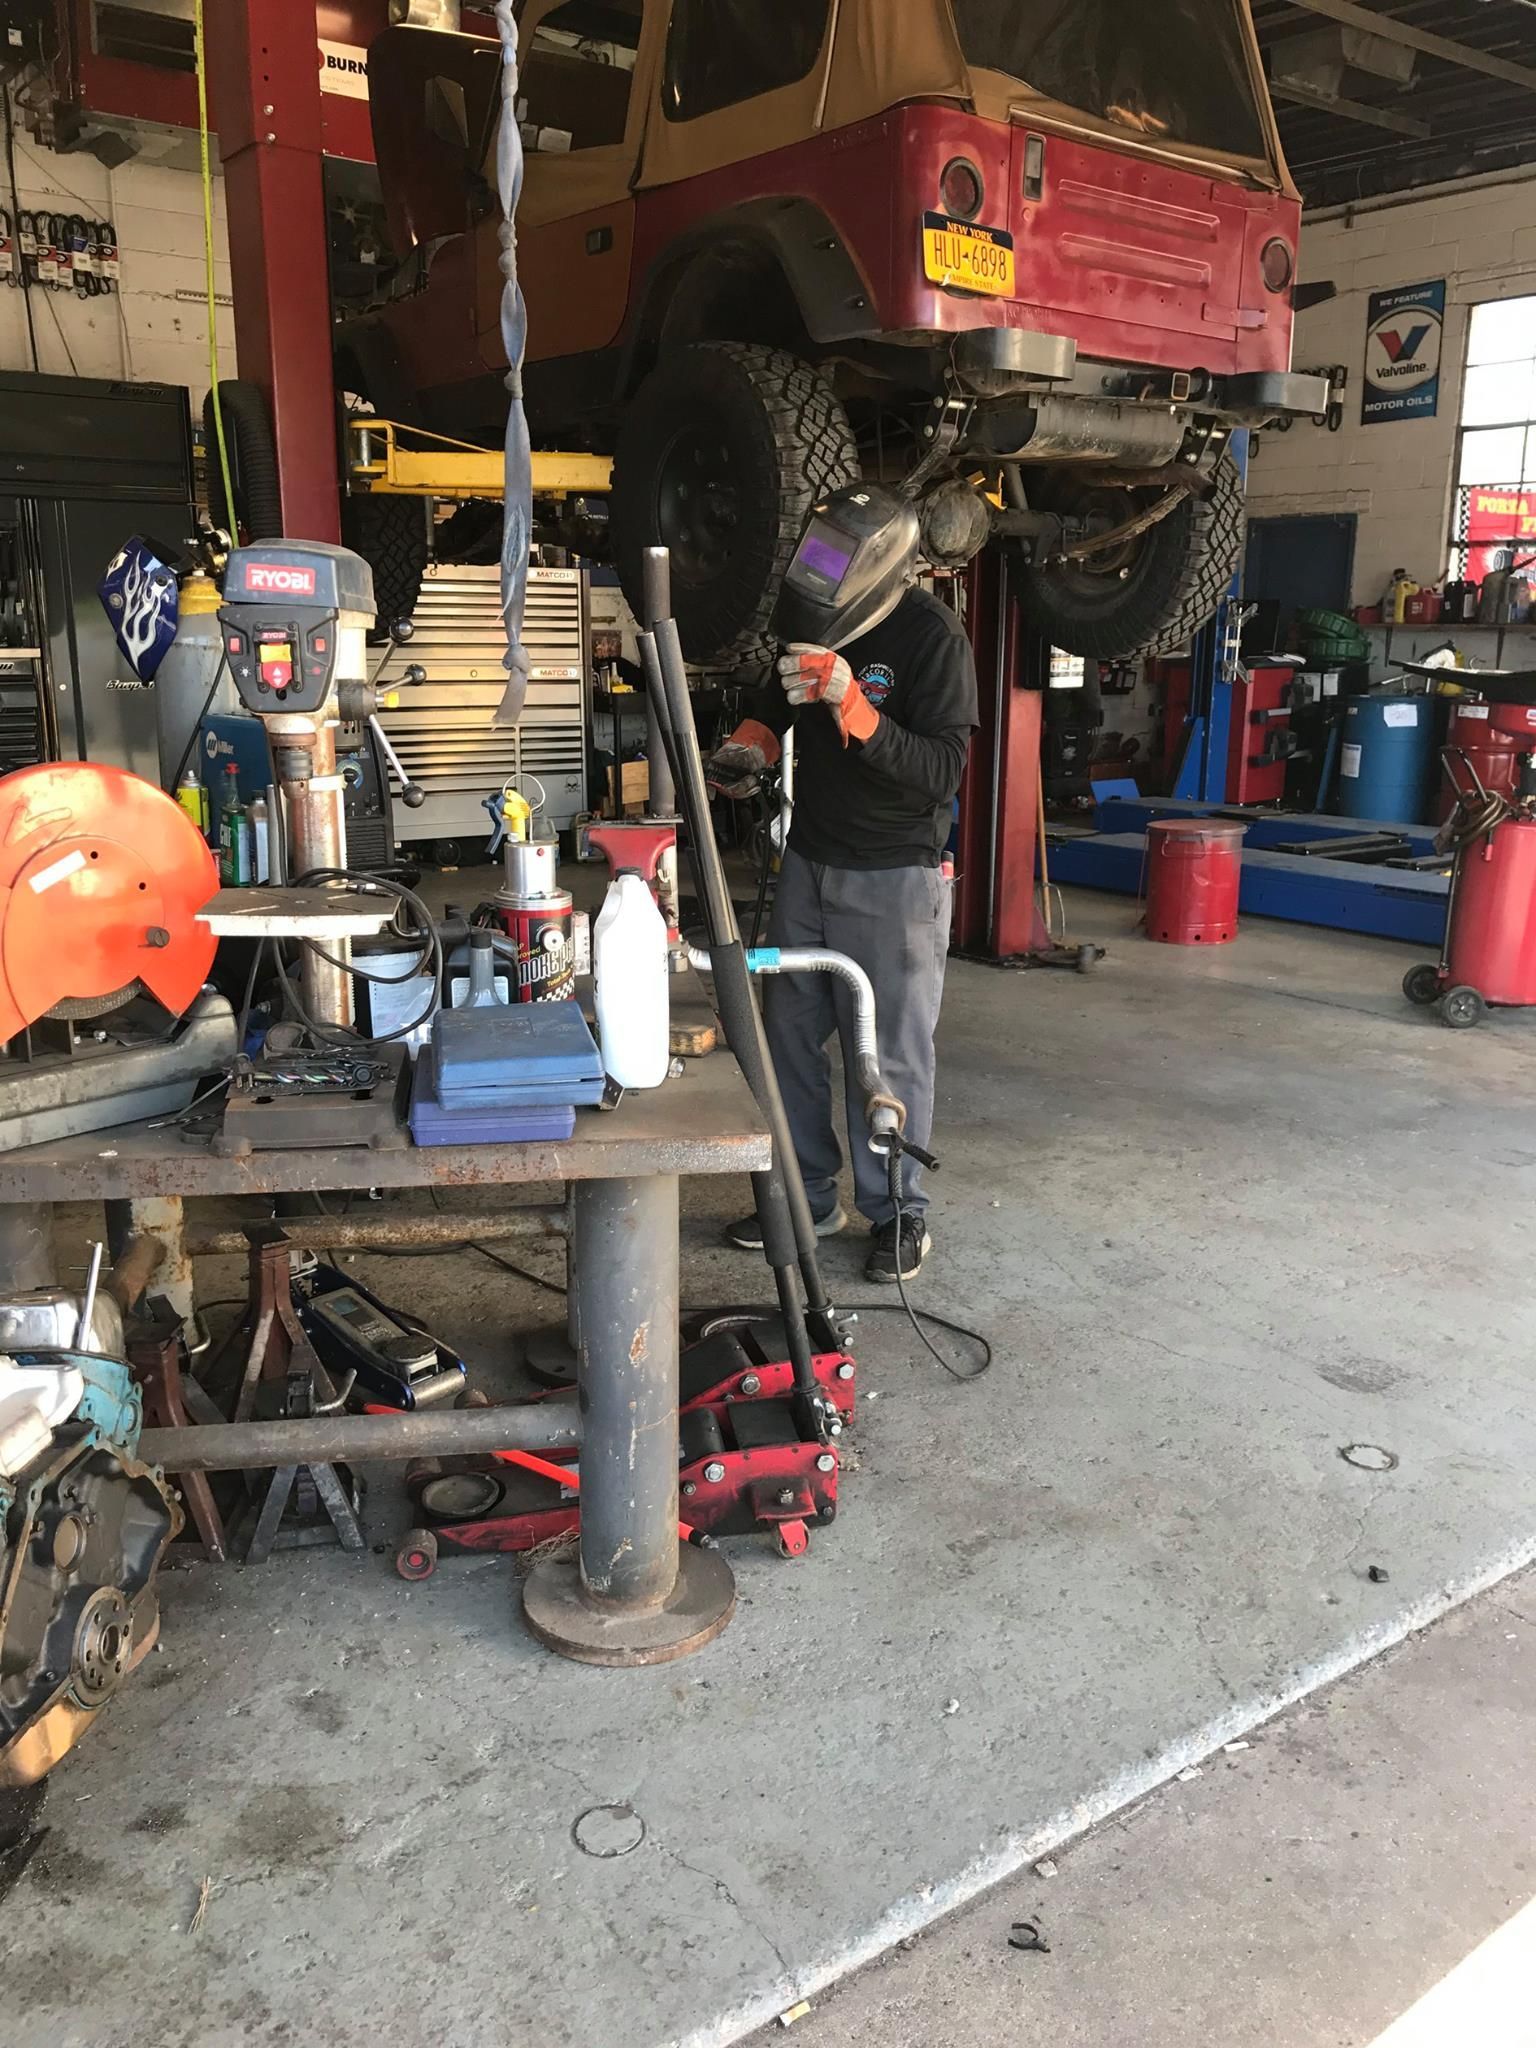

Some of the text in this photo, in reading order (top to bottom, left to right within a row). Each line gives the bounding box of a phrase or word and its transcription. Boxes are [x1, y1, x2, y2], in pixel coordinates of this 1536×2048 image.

[327, 55, 368, 75] BURN
[946, 221, 993, 243] NEW YORK
[1380, 290, 1432, 306] WE FEATURE
[1376, 363, 1427, 378] Valvoline
[1365, 395, 1433, 412] MOTOR OILS
[250, 569, 312, 590] RYOBI
[536, 570, 566, 579] MATCO
[261, 631, 287, 639] RYOBI
[539, 668, 569, 676] MATCO
